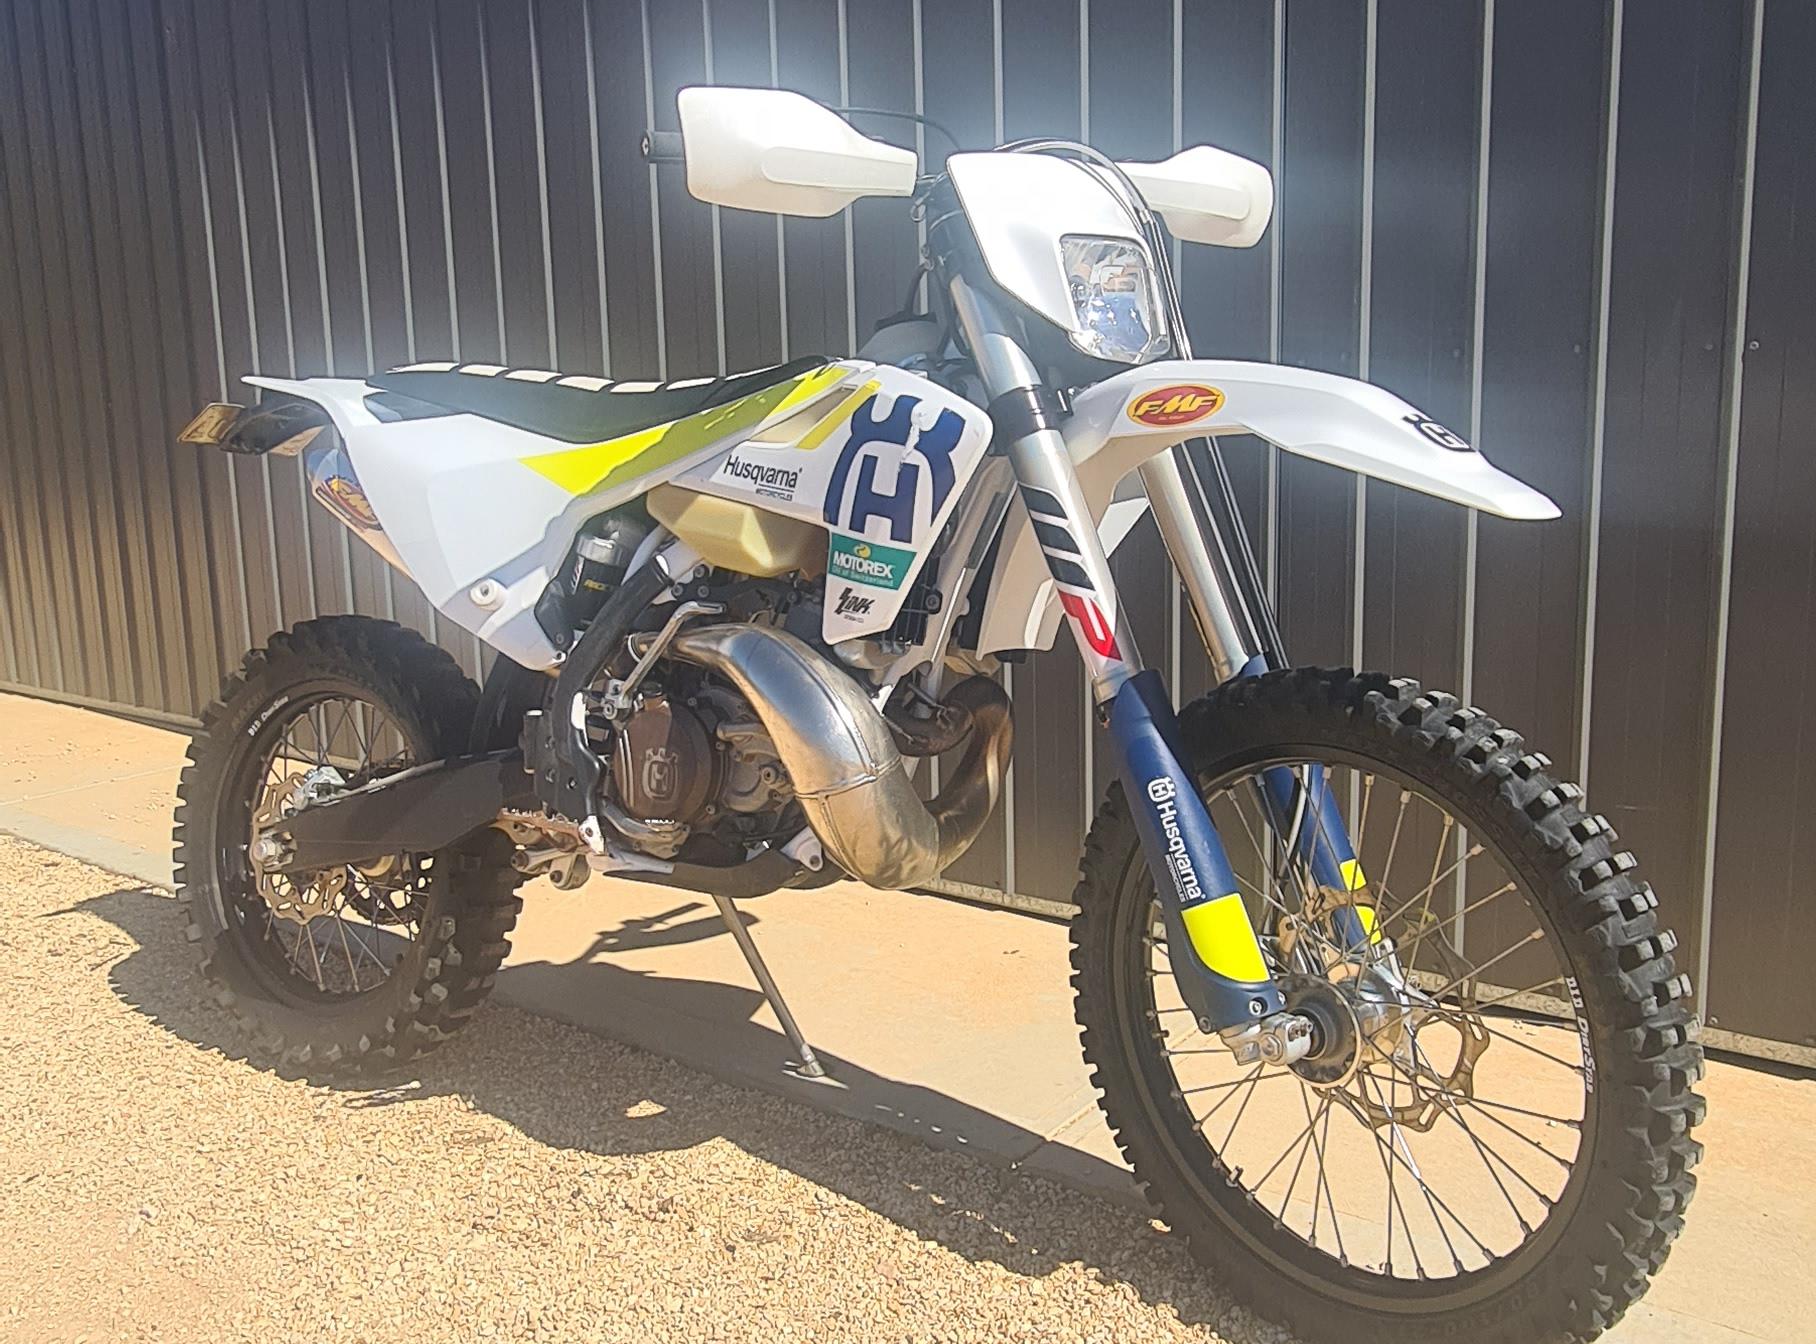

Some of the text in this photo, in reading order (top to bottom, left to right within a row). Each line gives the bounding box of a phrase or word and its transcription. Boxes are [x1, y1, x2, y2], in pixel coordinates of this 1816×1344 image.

[1135, 393, 1217, 417] FMF
[723, 454, 799, 488] Husqvarna
[833, 550, 896, 579] MOTOREX
[1156, 800, 1202, 899] Husqvarna
